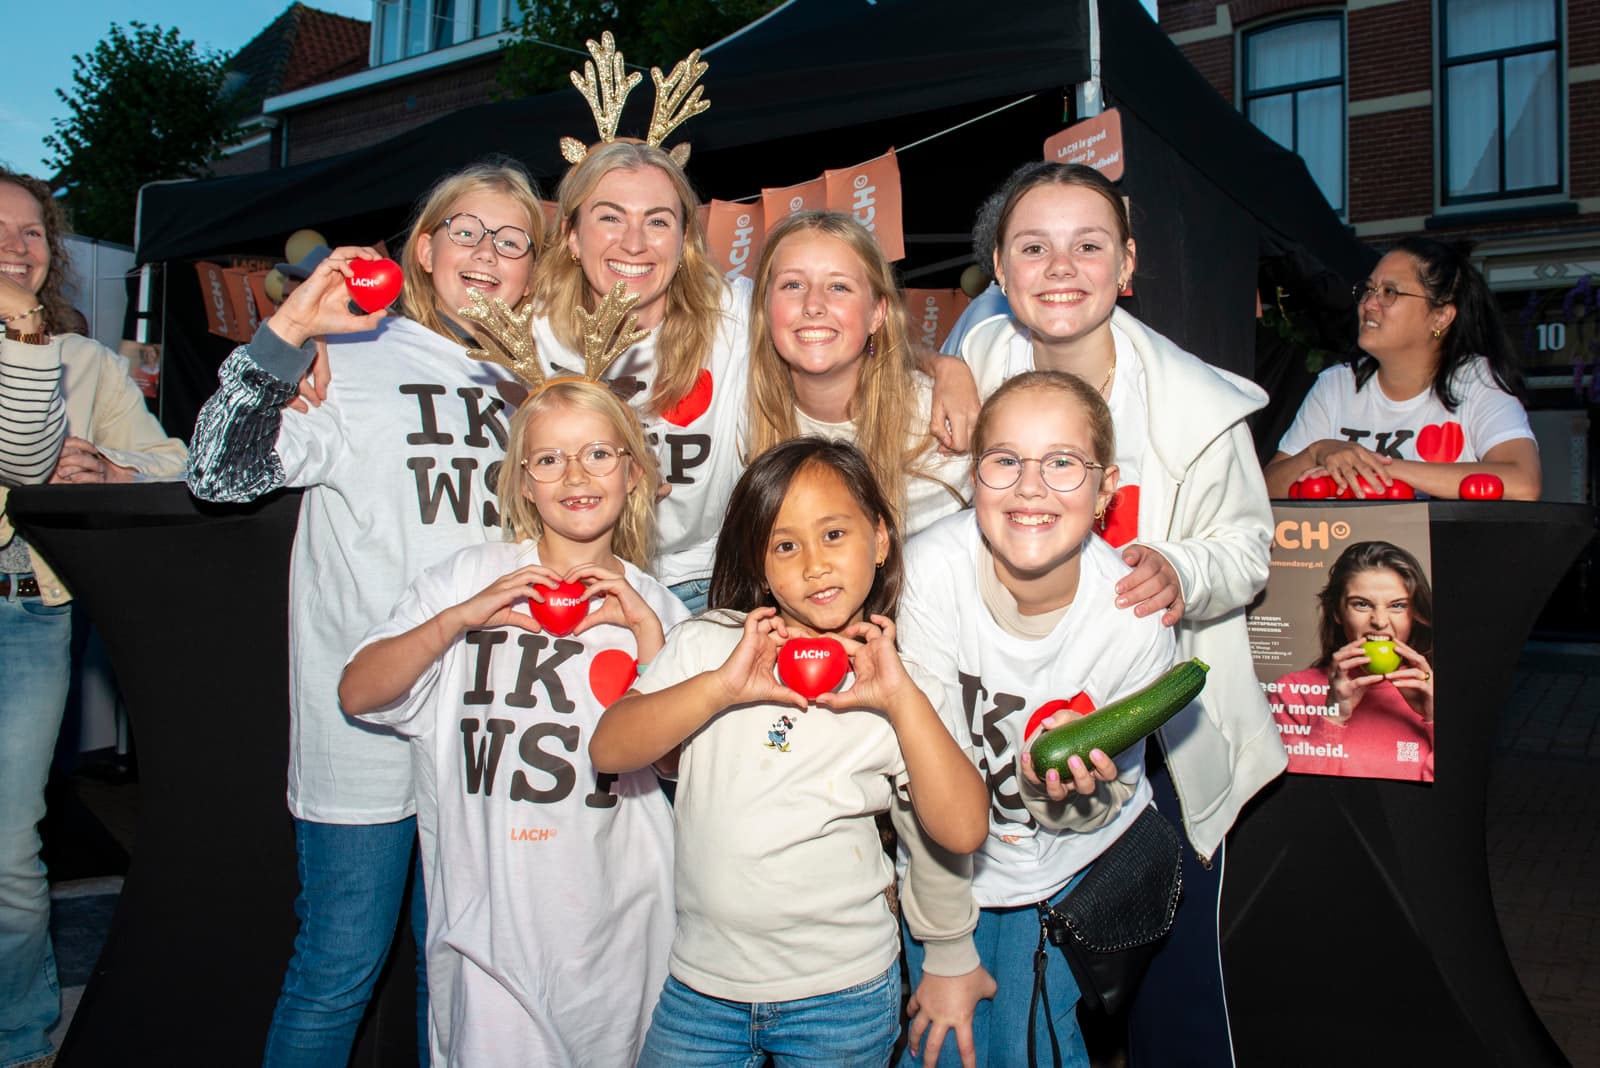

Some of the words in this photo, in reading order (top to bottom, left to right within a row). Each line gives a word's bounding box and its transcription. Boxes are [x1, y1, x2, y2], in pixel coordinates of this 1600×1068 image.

[726, 226, 754, 280] ACH
[351, 278, 375, 287] LACH
[1536, 323, 1566, 351] 10
[398, 383, 510, 452] IK
[550, 597, 576, 607] LACH
[794, 649, 824, 660] LACH
[463, 630, 585, 714] IK
[1289, 683, 1330, 695] voor
[1288, 703, 1339, 716] mond
[460, 718, 618, 809] WS
[511, 827, 549, 841] LACH
